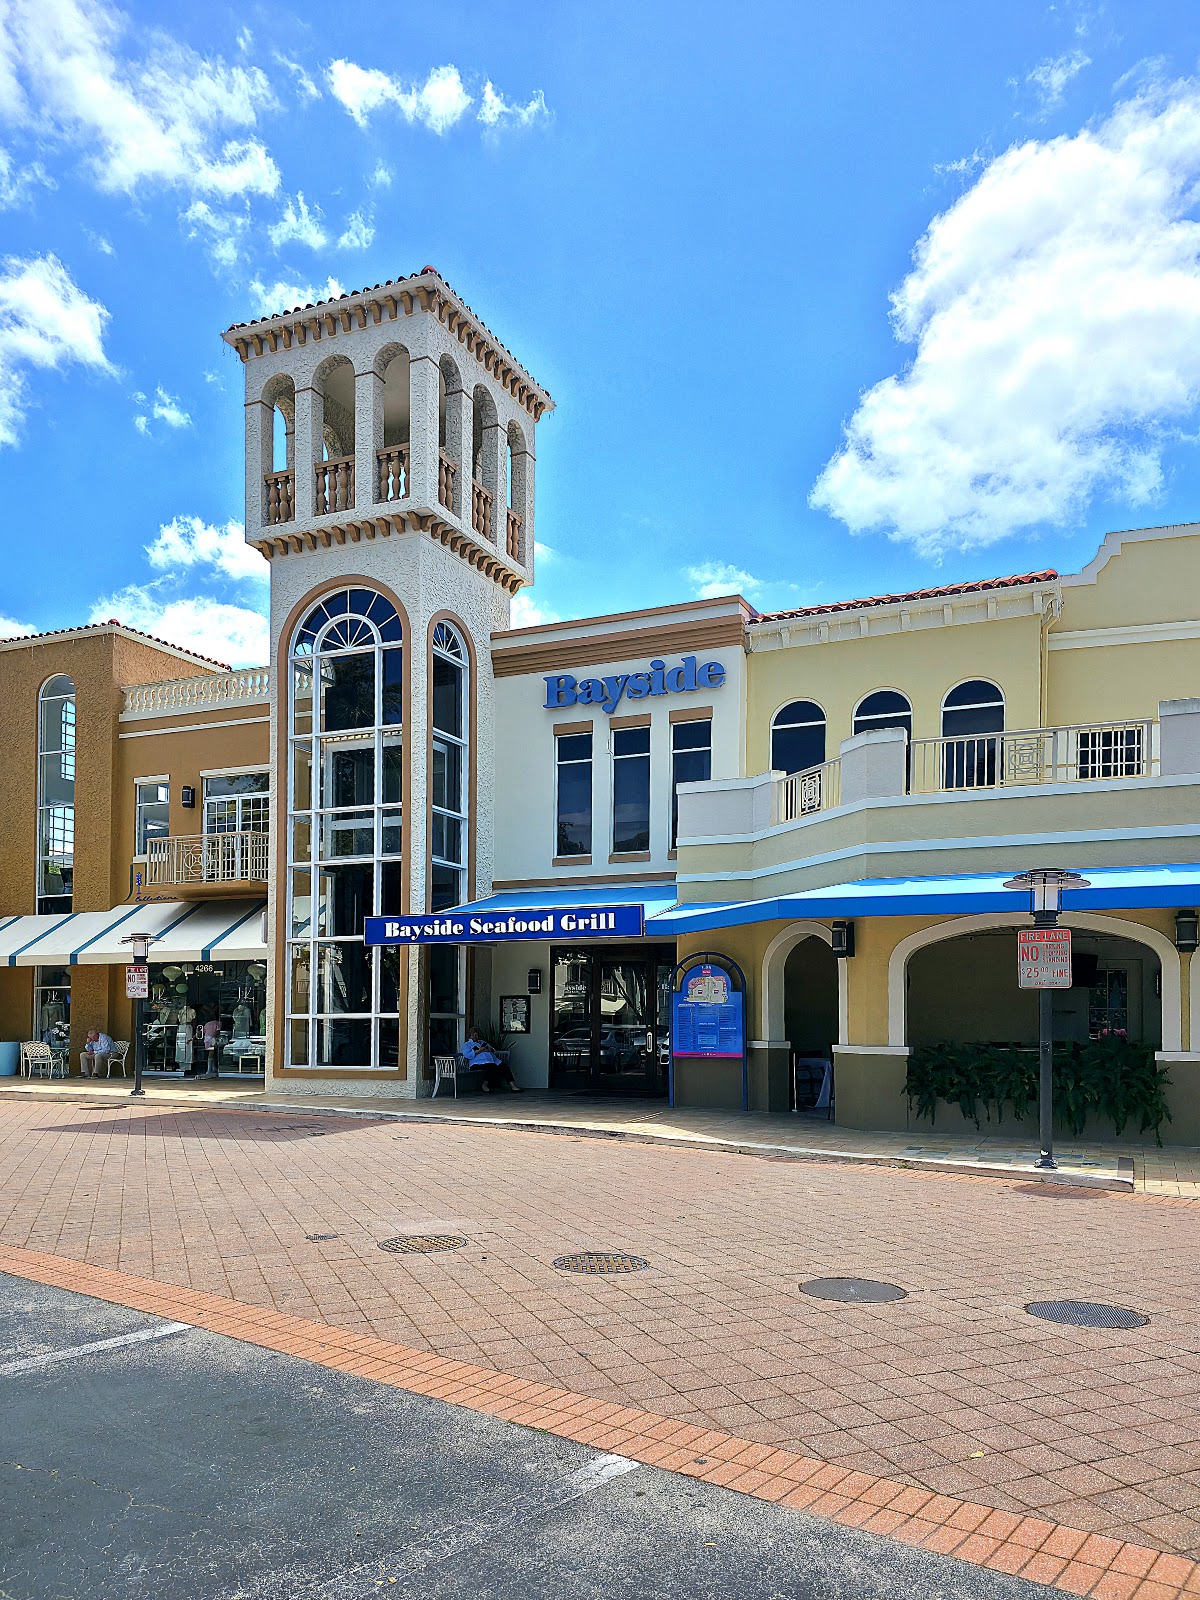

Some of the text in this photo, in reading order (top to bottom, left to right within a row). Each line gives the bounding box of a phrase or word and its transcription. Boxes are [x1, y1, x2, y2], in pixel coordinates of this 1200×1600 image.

[543, 656, 726, 714] Bayside
[385, 912, 616, 940] Bayside Seafood Grill
[1020, 932, 1069, 941] FIRE LANE
[1021, 945, 1039, 961] NO
[1052, 969, 1068, 977] FINE
